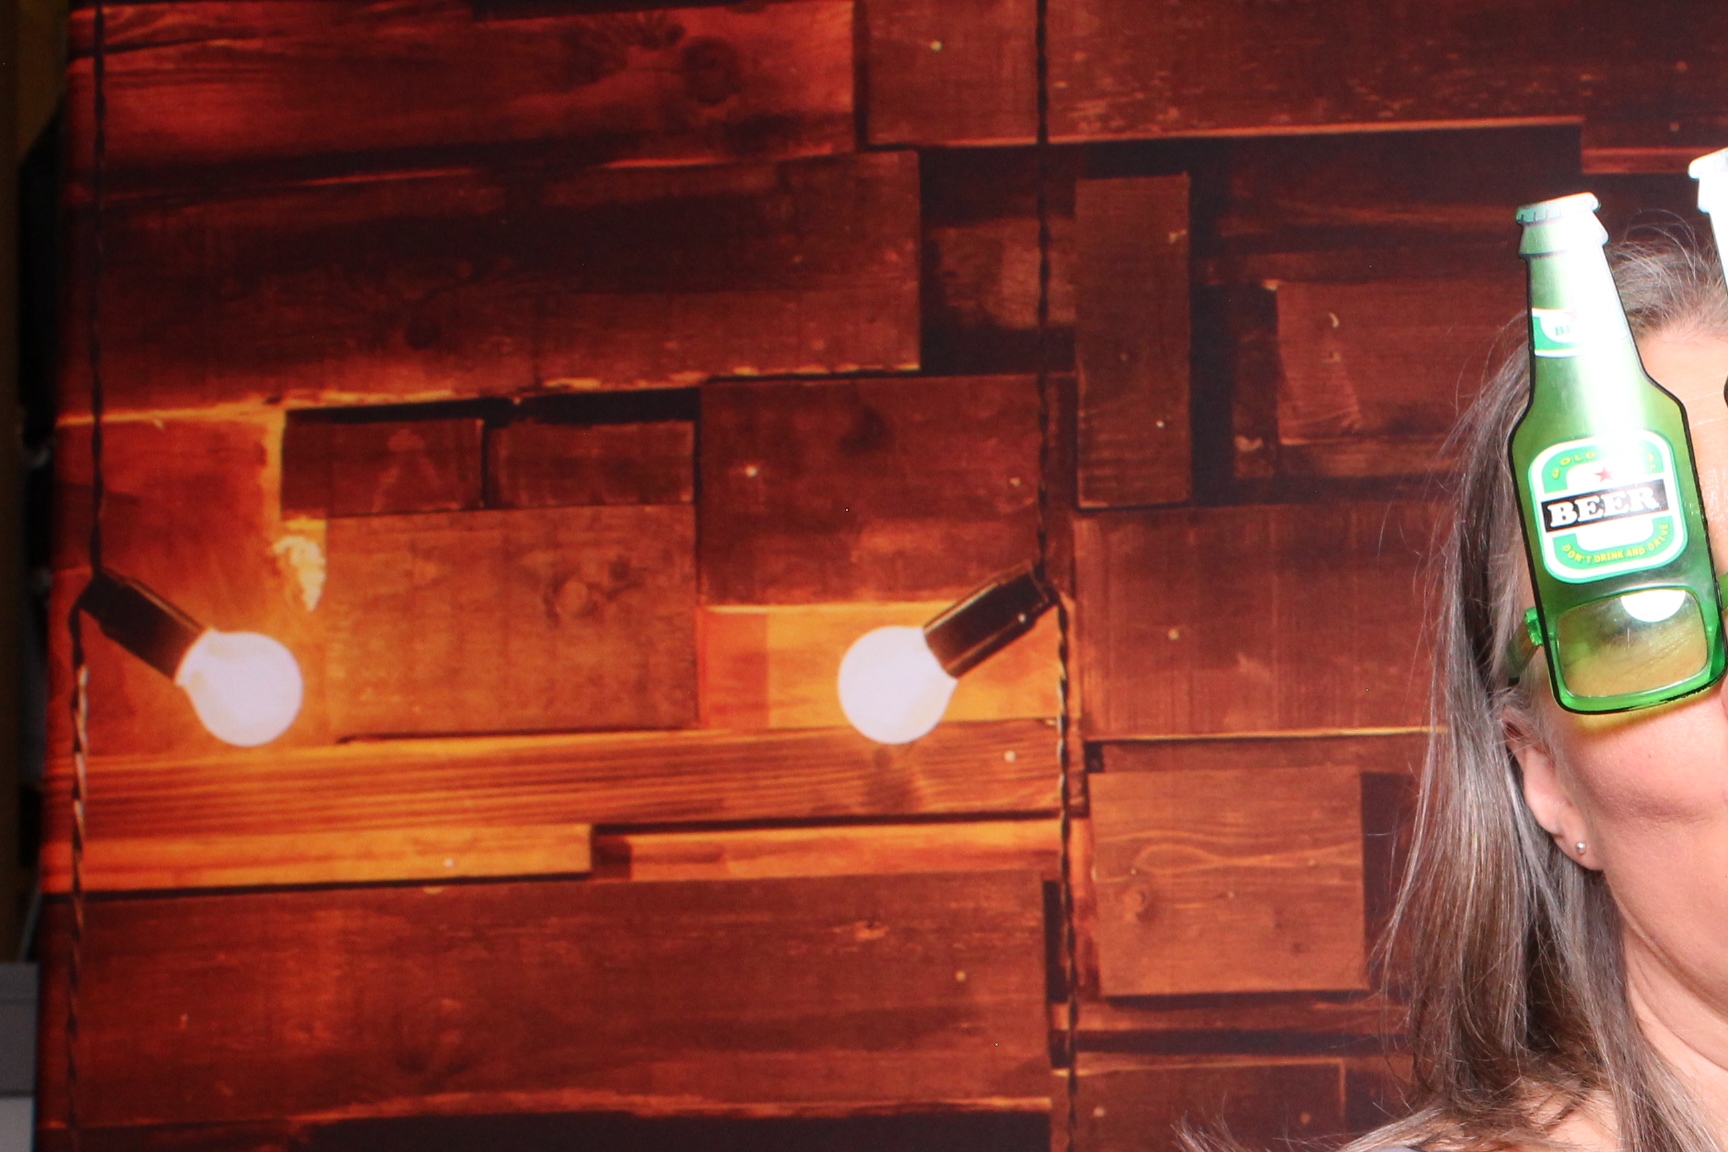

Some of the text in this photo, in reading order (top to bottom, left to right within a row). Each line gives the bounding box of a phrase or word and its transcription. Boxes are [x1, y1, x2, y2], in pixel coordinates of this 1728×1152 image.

[1547, 486, 1661, 528] BEER
[1562, 523, 1670, 563] DON'T DRINK AND DRIVE
